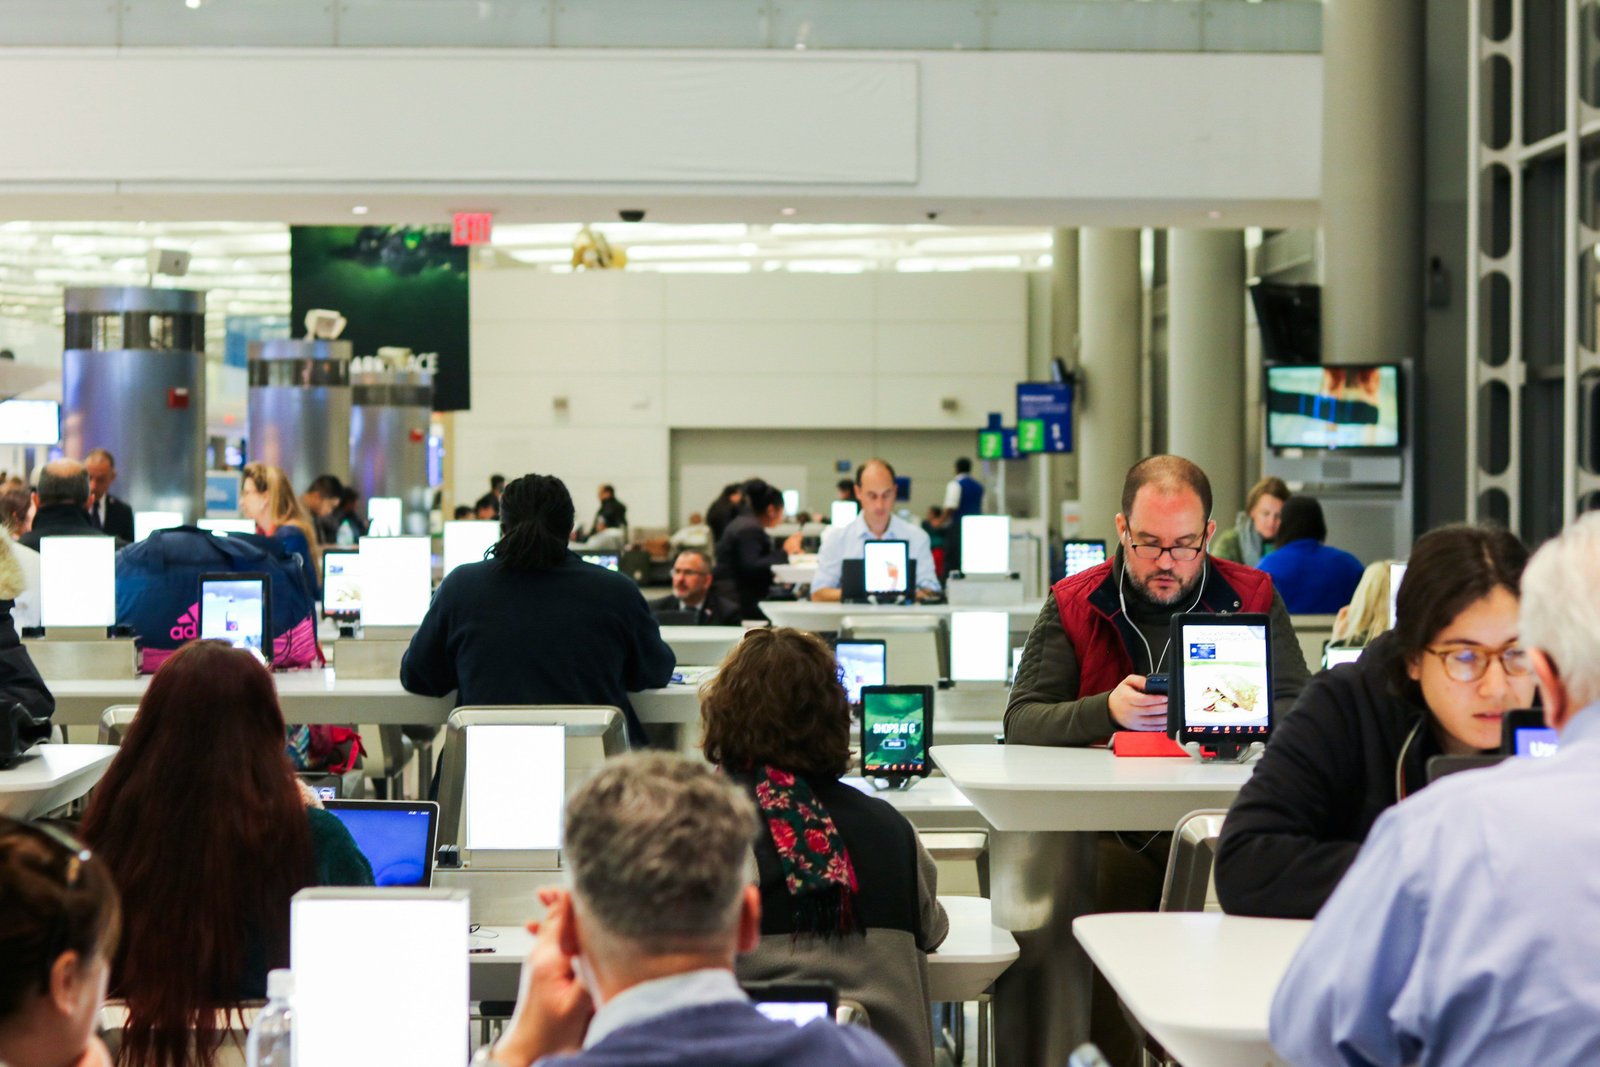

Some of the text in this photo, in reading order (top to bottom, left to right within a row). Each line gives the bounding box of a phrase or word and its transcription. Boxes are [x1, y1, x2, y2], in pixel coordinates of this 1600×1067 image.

[454, 214, 491, 244] EXIT
[170, 622, 198, 640] ad
[873, 723, 899, 735] SHOPS
[899, 723, 909, 735] AT
